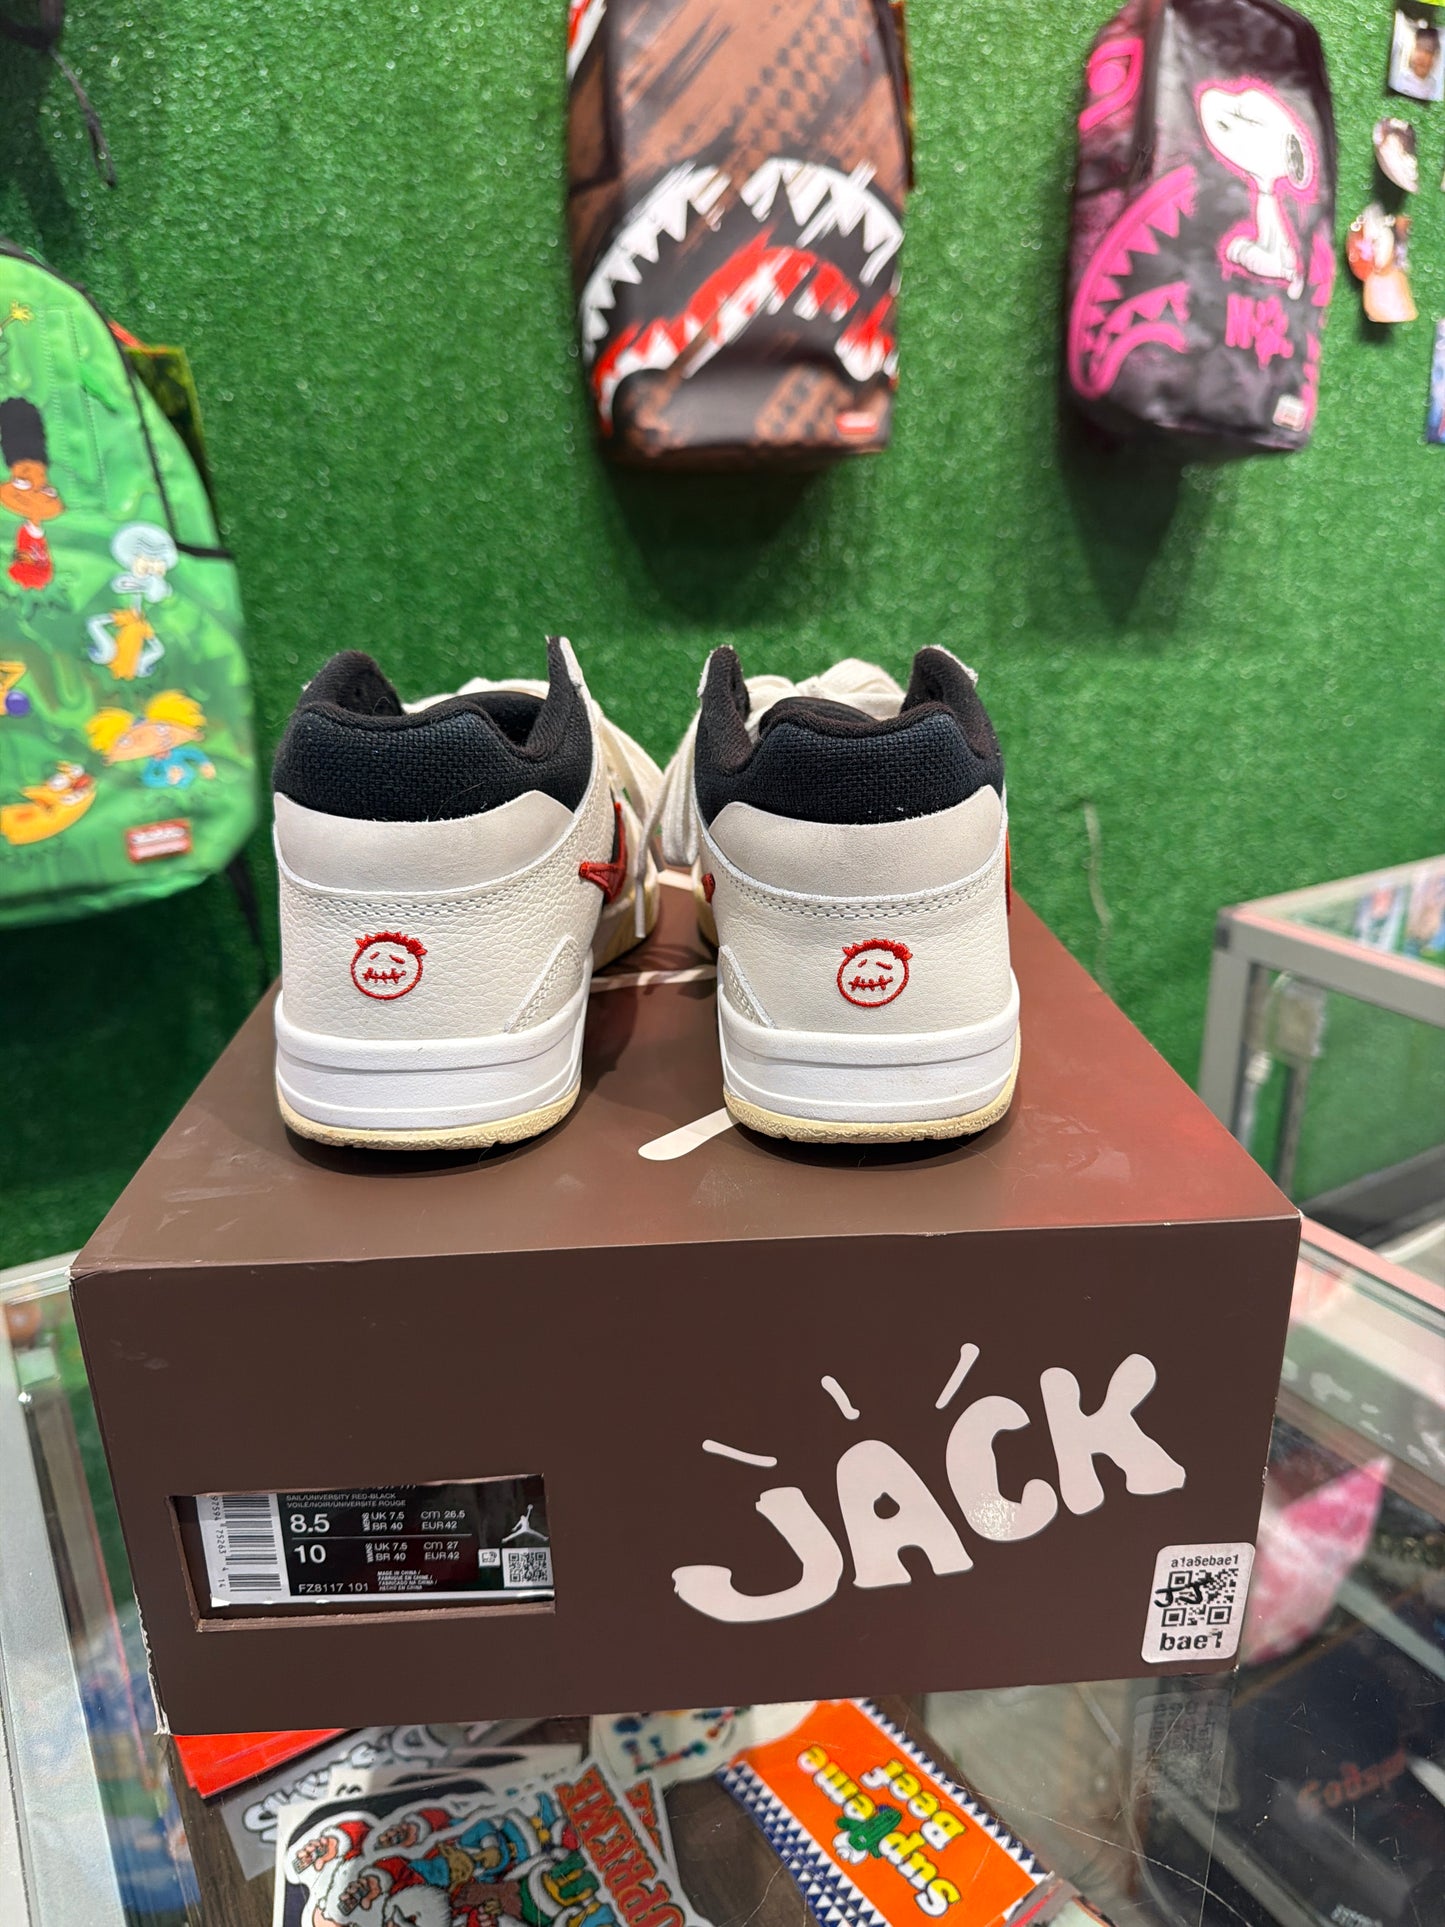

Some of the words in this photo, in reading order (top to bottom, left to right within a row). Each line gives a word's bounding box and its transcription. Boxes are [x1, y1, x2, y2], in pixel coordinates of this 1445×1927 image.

[672, 1353, 1186, 1623] JACK
[286, 1494, 350, 1502] SAIL/UNIVERSITY
[351, 1492, 396, 1500] RED-BLACK
[378, 1500, 406, 1508] ROUGE
[371, 1512, 387, 1520] UK
[389, 1511, 405, 1520] 7.5
[444, 1509, 466, 1519] 26.5
[289, 1513, 330, 1533] 8.5
[372, 1522, 388, 1531] BR
[390, 1521, 404, 1531] 40
[422, 1521, 444, 1530] EUR
[445, 1520, 458, 1530] 42
[374, 1543, 390, 1551] UK
[392, 1542, 408, 1551] 7.5
[447, 1541, 459, 1550] 27
[294, 1544, 327, 1564] 10
[376, 1553, 391, 1561] BR
[394, 1552, 407, 1561] 40
[424, 1552, 447, 1561] EUR
[447, 1551, 460, 1560] 42
[299, 1583, 344, 1593] FZ8117
[348, 1583, 369, 1592] 101
[1160, 1630, 1223, 1651] bae1
[859, 1758, 967, 1852] Beef
